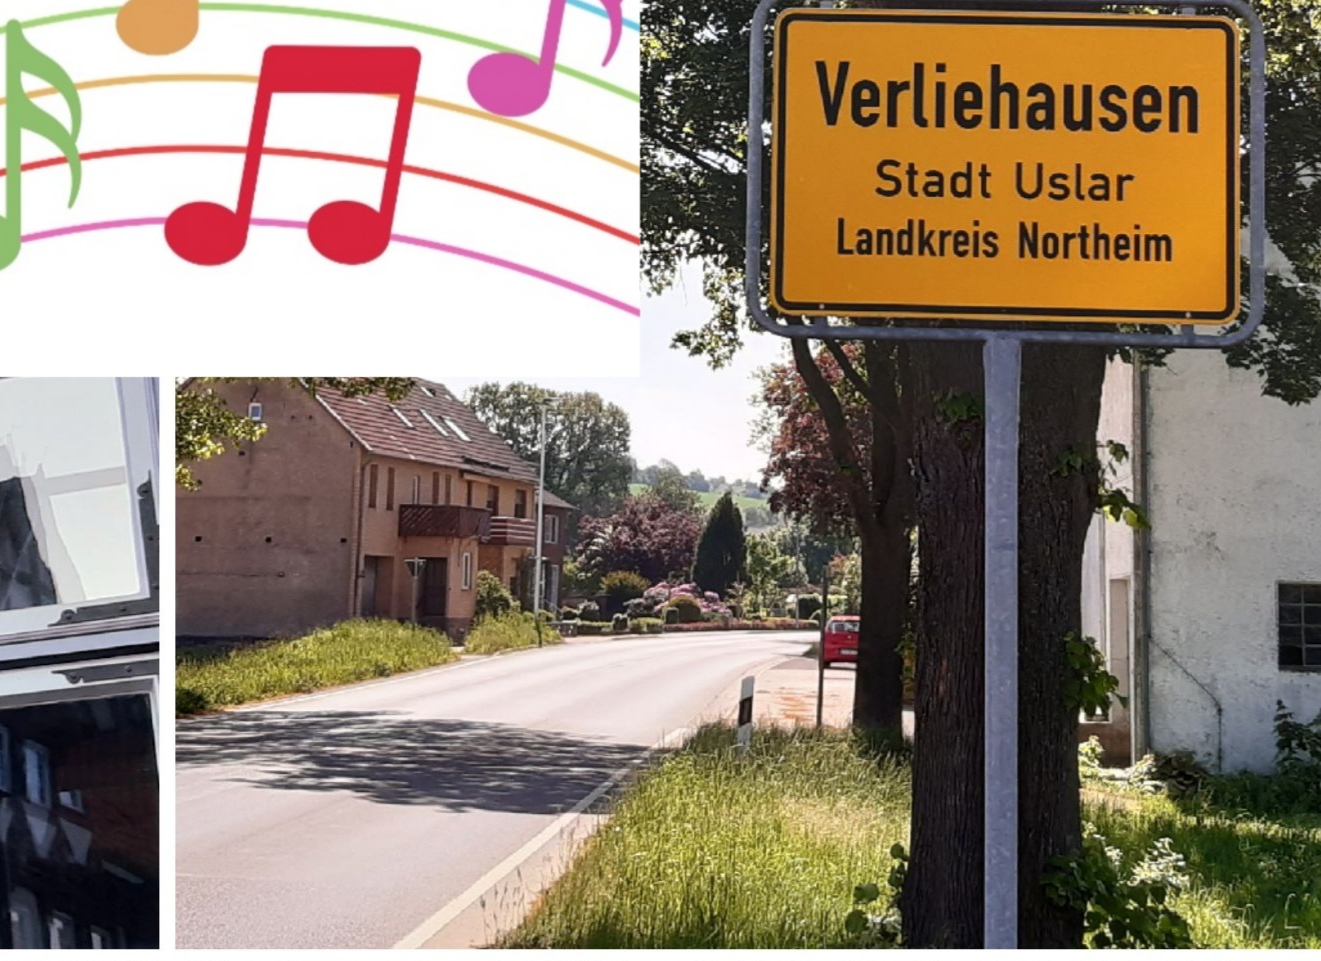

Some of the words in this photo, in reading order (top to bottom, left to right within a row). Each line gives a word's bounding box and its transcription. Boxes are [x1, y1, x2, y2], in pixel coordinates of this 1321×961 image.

[814, 60, 1200, 134] Verliehausen
[874, 159, 992, 199] Stadt
[1014, 162, 1136, 202] Uslar
[836, 217, 999, 259] Landkreis
[1018, 221, 1173, 262] Northeim
